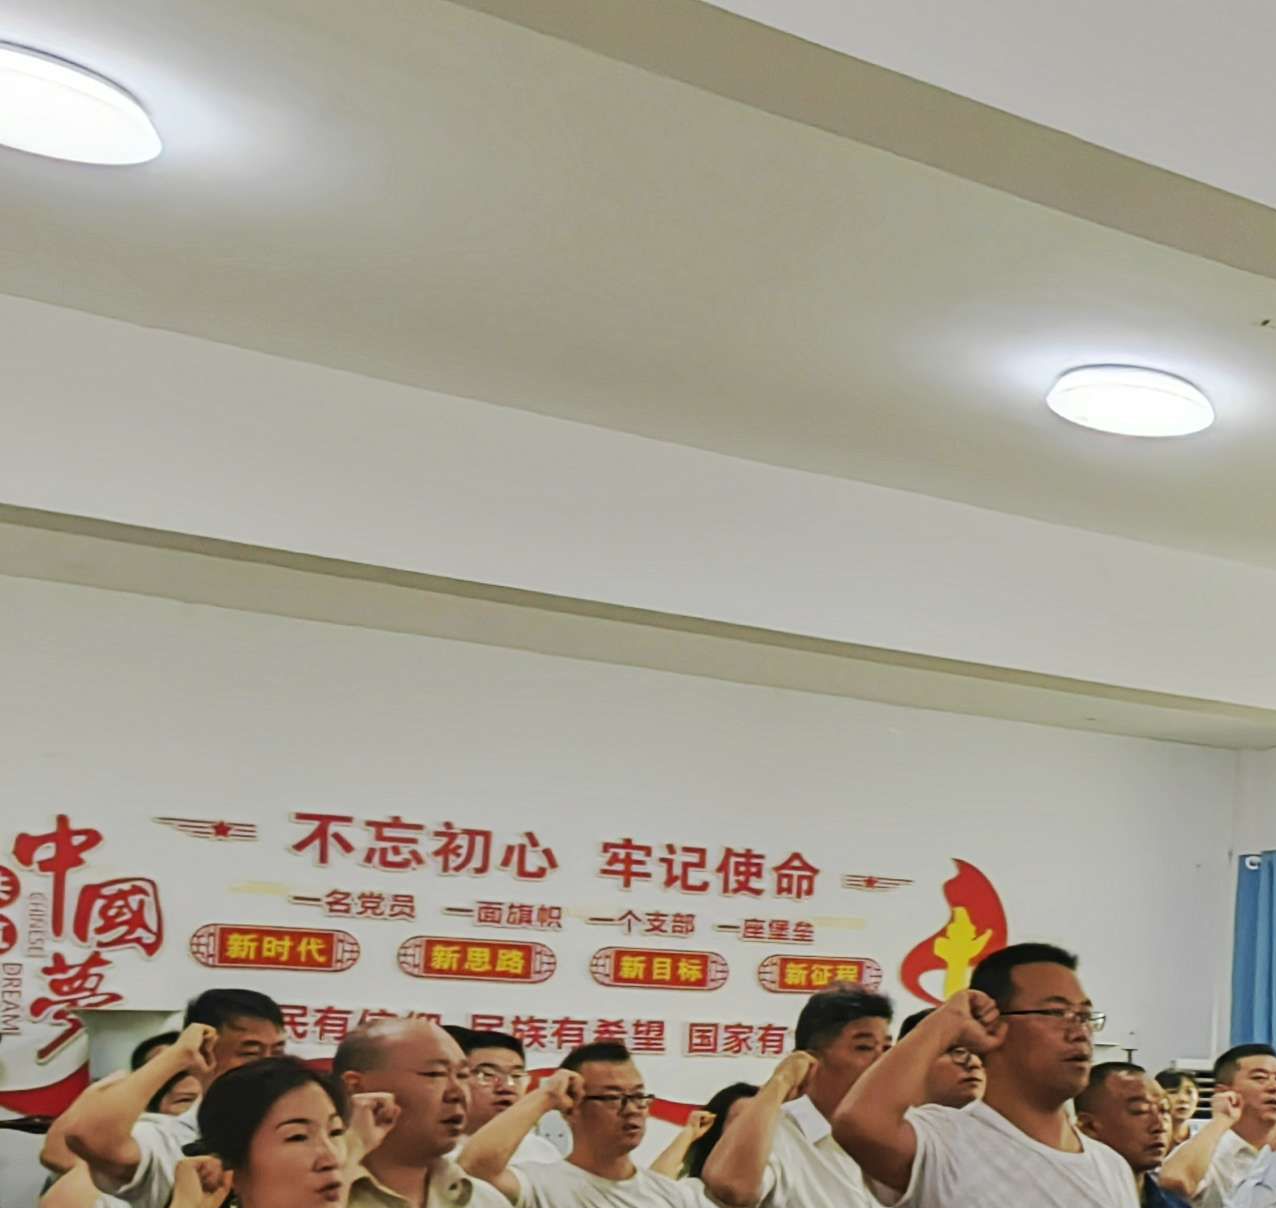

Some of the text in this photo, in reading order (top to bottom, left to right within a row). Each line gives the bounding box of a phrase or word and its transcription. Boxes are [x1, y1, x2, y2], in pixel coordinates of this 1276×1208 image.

[291, 812, 820, 899] 不忘初心 牢记使命
[292, 889, 815, 942] 一名党员 一面旗帜 一个支部 一座堡垒
[226, 932, 327, 963] 新时代
[430, 944, 525, 975] 新思路
[618, 955, 704, 982] 新目标
[784, 962, 859, 986] 新征程
